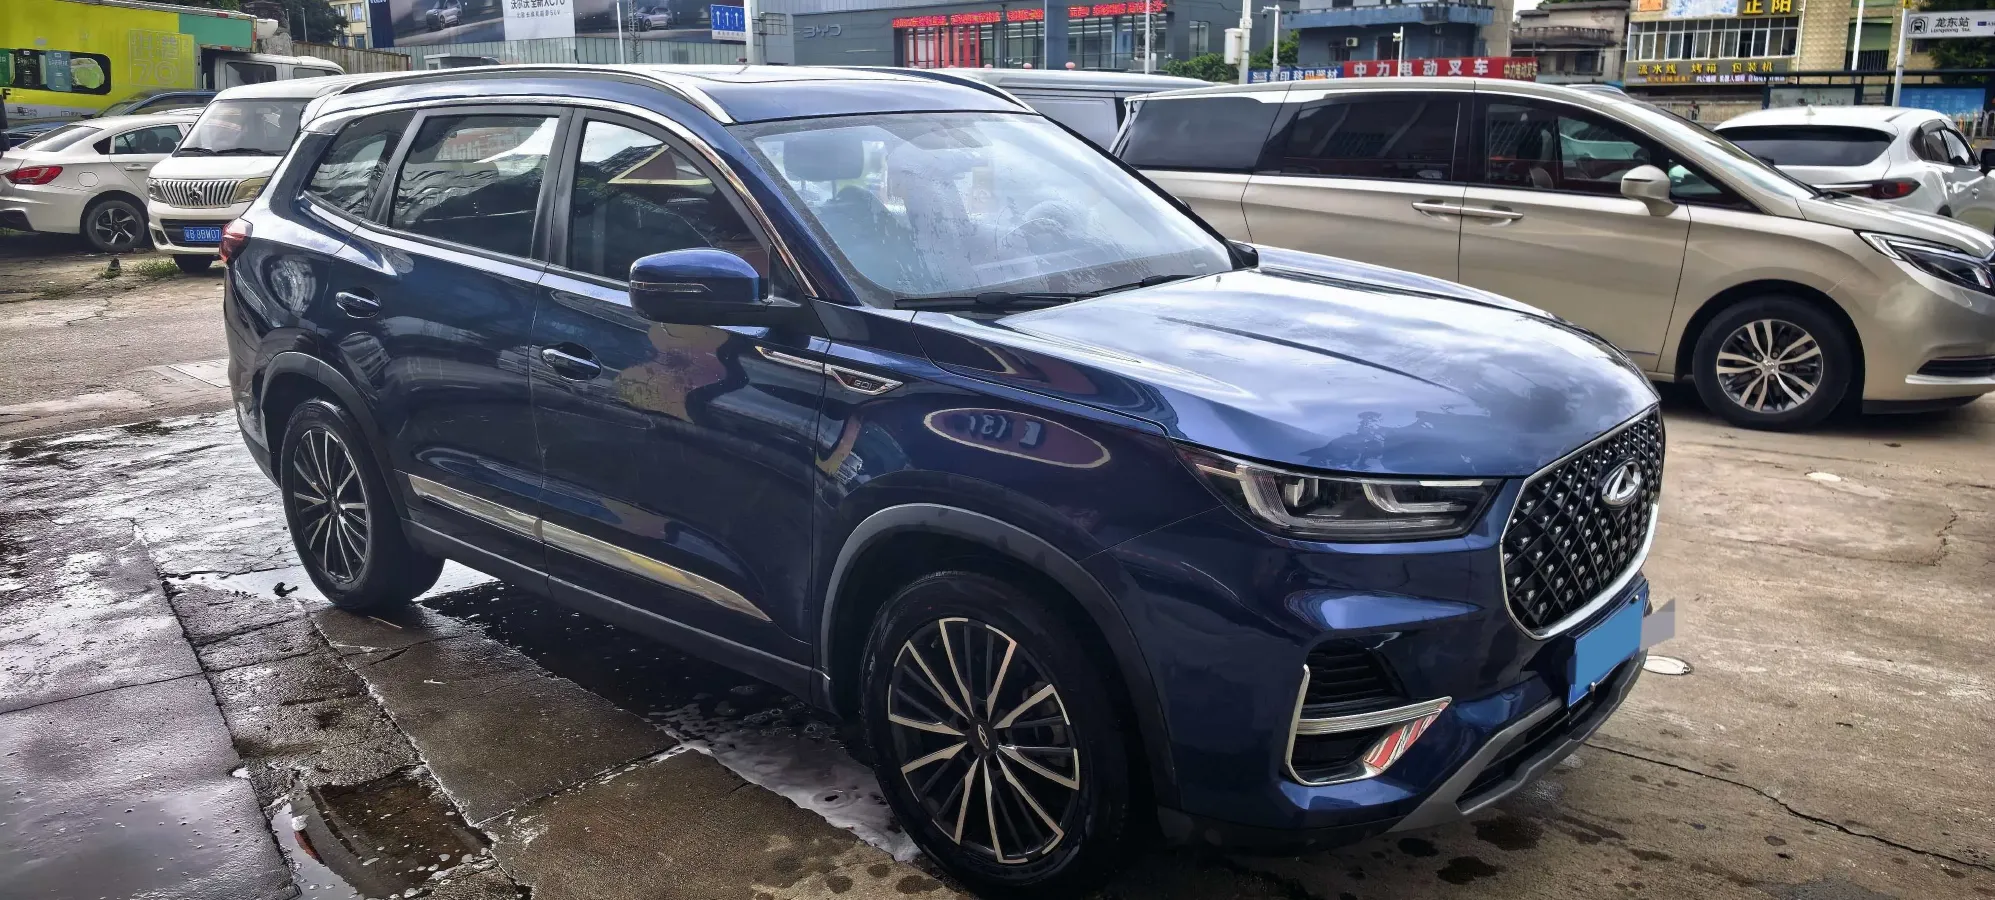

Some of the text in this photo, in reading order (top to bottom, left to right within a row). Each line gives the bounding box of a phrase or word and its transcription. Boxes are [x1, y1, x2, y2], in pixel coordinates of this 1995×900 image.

[1935, 17, 1970, 28] 龙东站
[804, 24, 842, 38] BYD
[1354, 58, 1489, 77] 中力电动叉车
